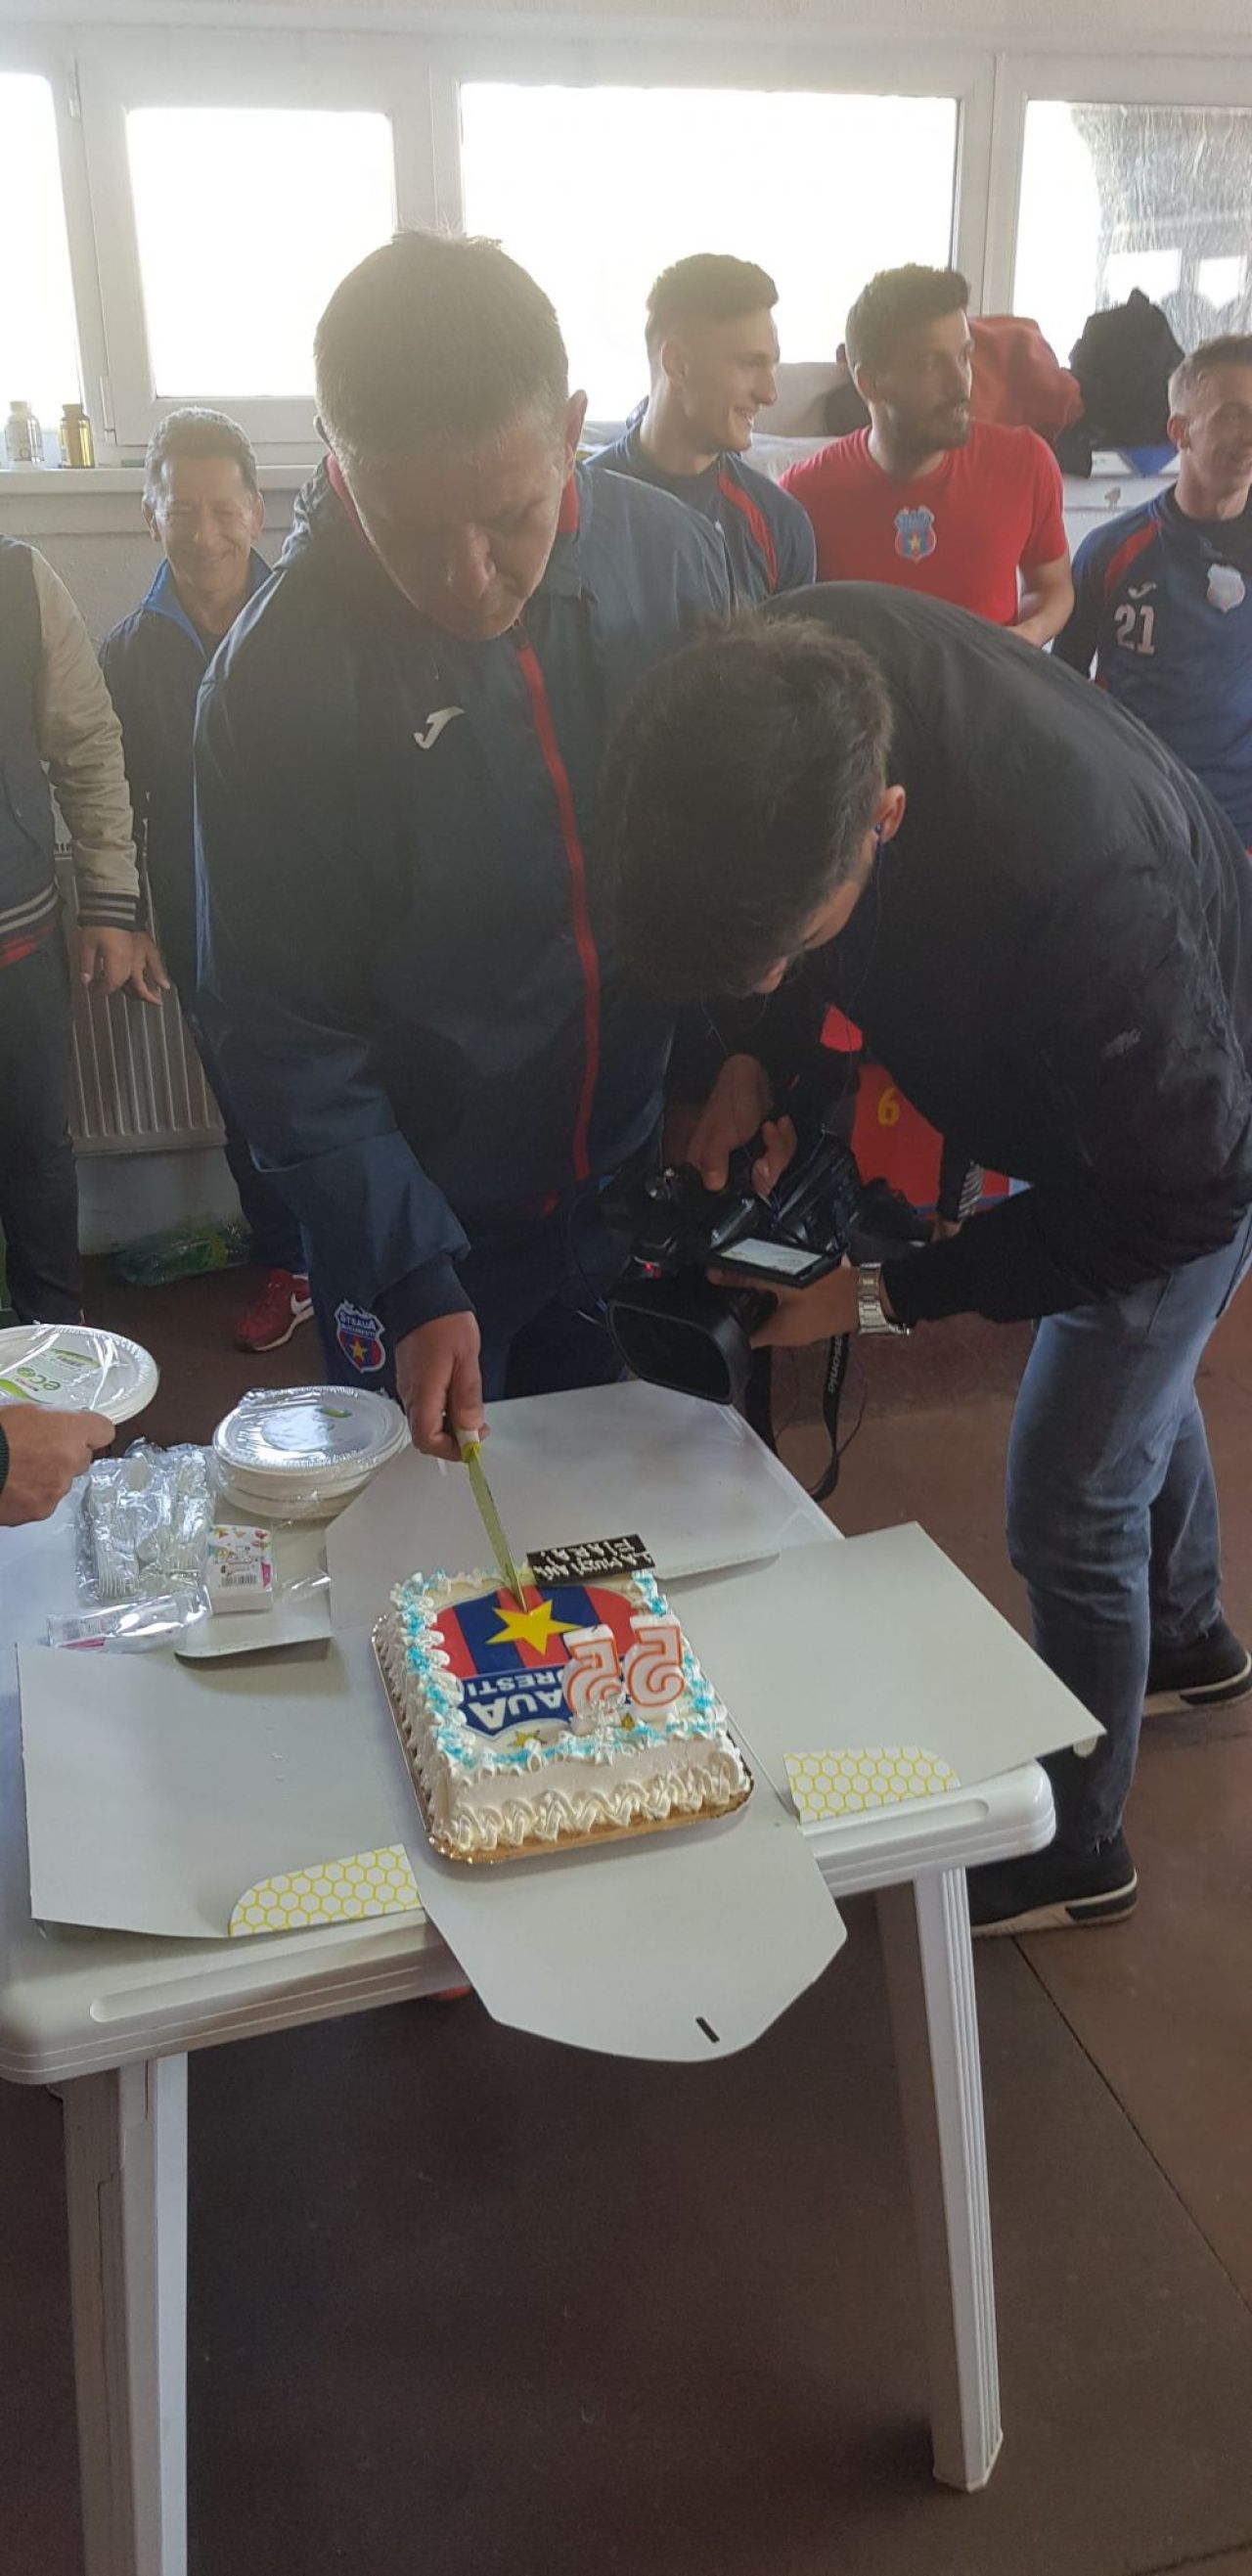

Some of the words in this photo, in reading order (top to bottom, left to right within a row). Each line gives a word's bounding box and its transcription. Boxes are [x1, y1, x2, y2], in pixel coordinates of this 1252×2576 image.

[1113, 604, 1155, 655] 21
[878, 1087, 900, 1126] 6
[620, 1551, 651, 1566] LA
[467, 1668, 564, 1696] RESTI
[469, 1687, 564, 1730] AUA
